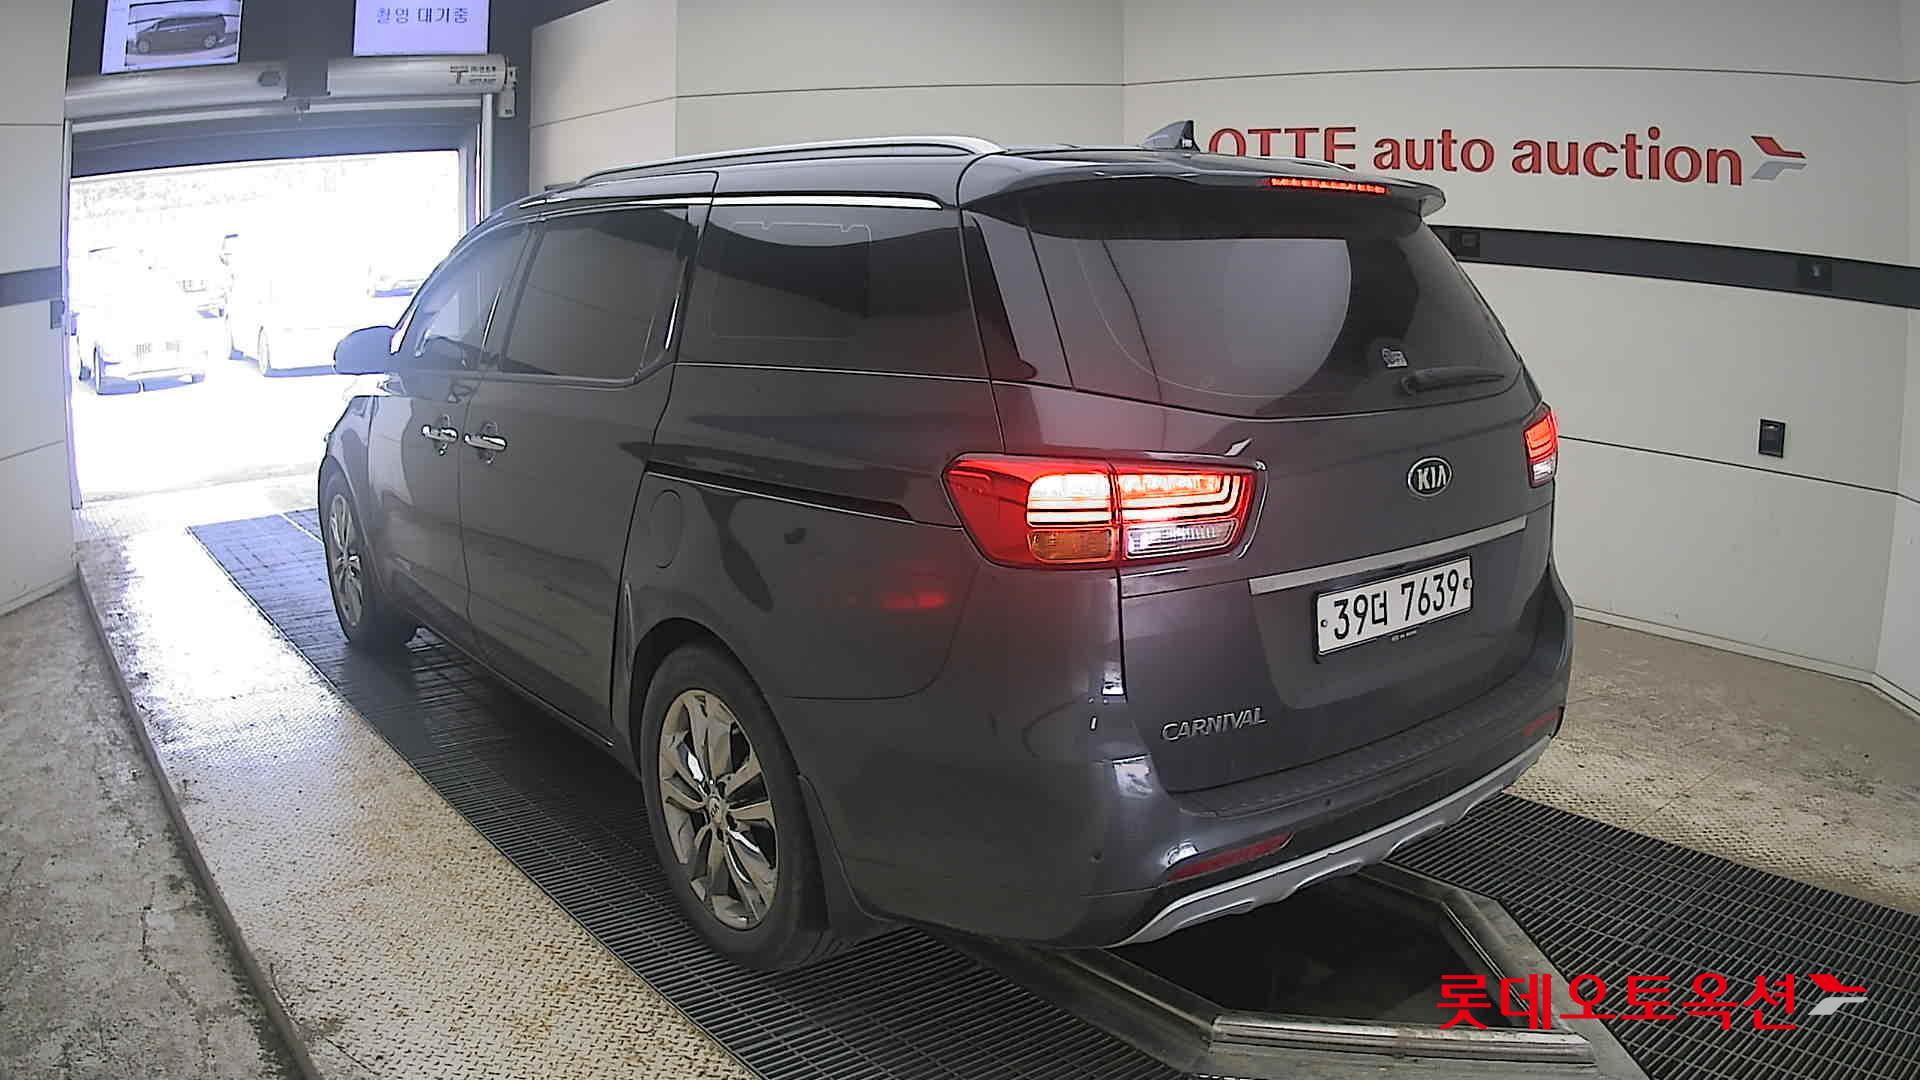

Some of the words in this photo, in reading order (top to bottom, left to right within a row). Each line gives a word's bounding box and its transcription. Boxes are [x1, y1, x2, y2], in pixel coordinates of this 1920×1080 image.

[417, 7, 469, 24] 대기중
[1373, 129, 1495, 173] auto
[1511, 126, 1743, 186] auction
[1417, 464, 1447, 491] KIA
[1334, 590, 1388, 640] 39더
[1401, 569, 1459, 622] 7639
[1162, 706, 1267, 741] CARNIVAL
